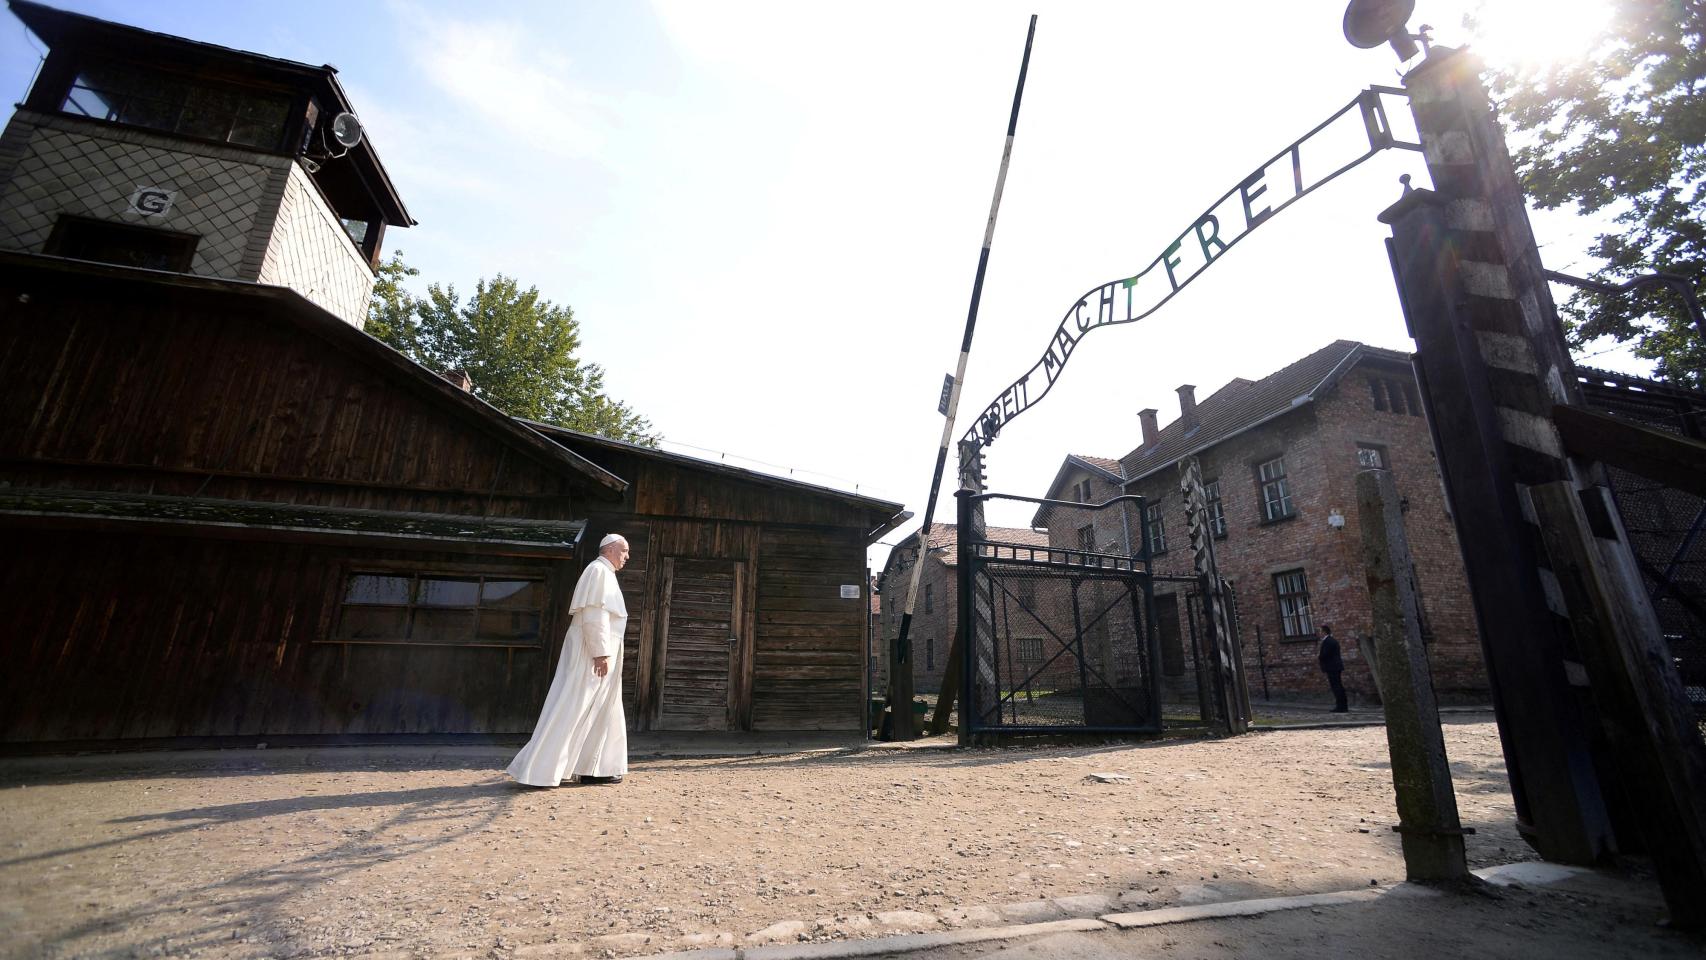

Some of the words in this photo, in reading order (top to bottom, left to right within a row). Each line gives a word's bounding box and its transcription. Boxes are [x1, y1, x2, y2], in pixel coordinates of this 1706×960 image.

[136, 191, 169, 213] G
[1042, 278, 1138, 384] MACHT
[1162, 144, 1303, 293] FREI
